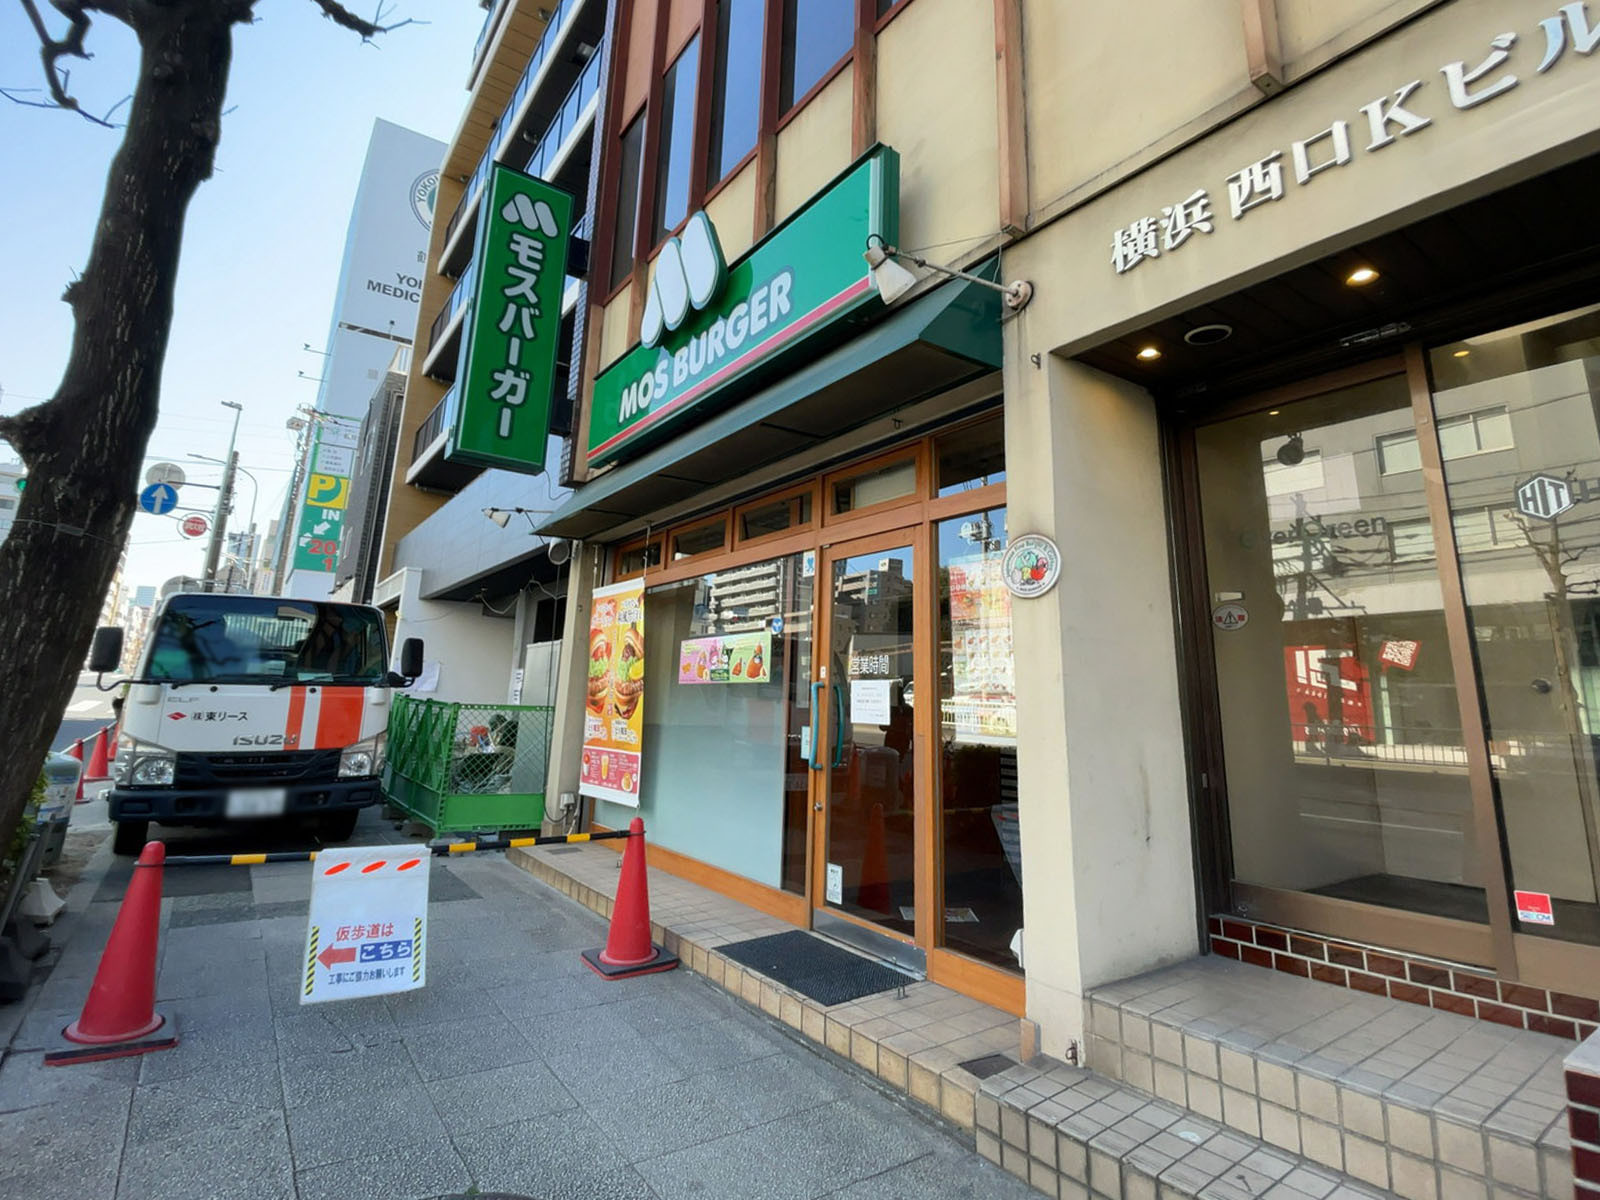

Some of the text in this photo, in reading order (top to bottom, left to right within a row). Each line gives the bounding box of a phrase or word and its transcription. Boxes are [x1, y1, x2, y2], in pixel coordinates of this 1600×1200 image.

[490, 232, 543, 438] モスバーガー
[618, 271, 792, 424] MOS BURGER
[321, 508, 341, 522] IN
[850, 654, 889, 675] 営業時間
[232, 734, 297, 746] ISUZU
[335, 922, 394, 942] 仮歩道は
[361, 942, 411, 960] こちら
[328, 966, 406, 985] 工事にご協力お願いします
